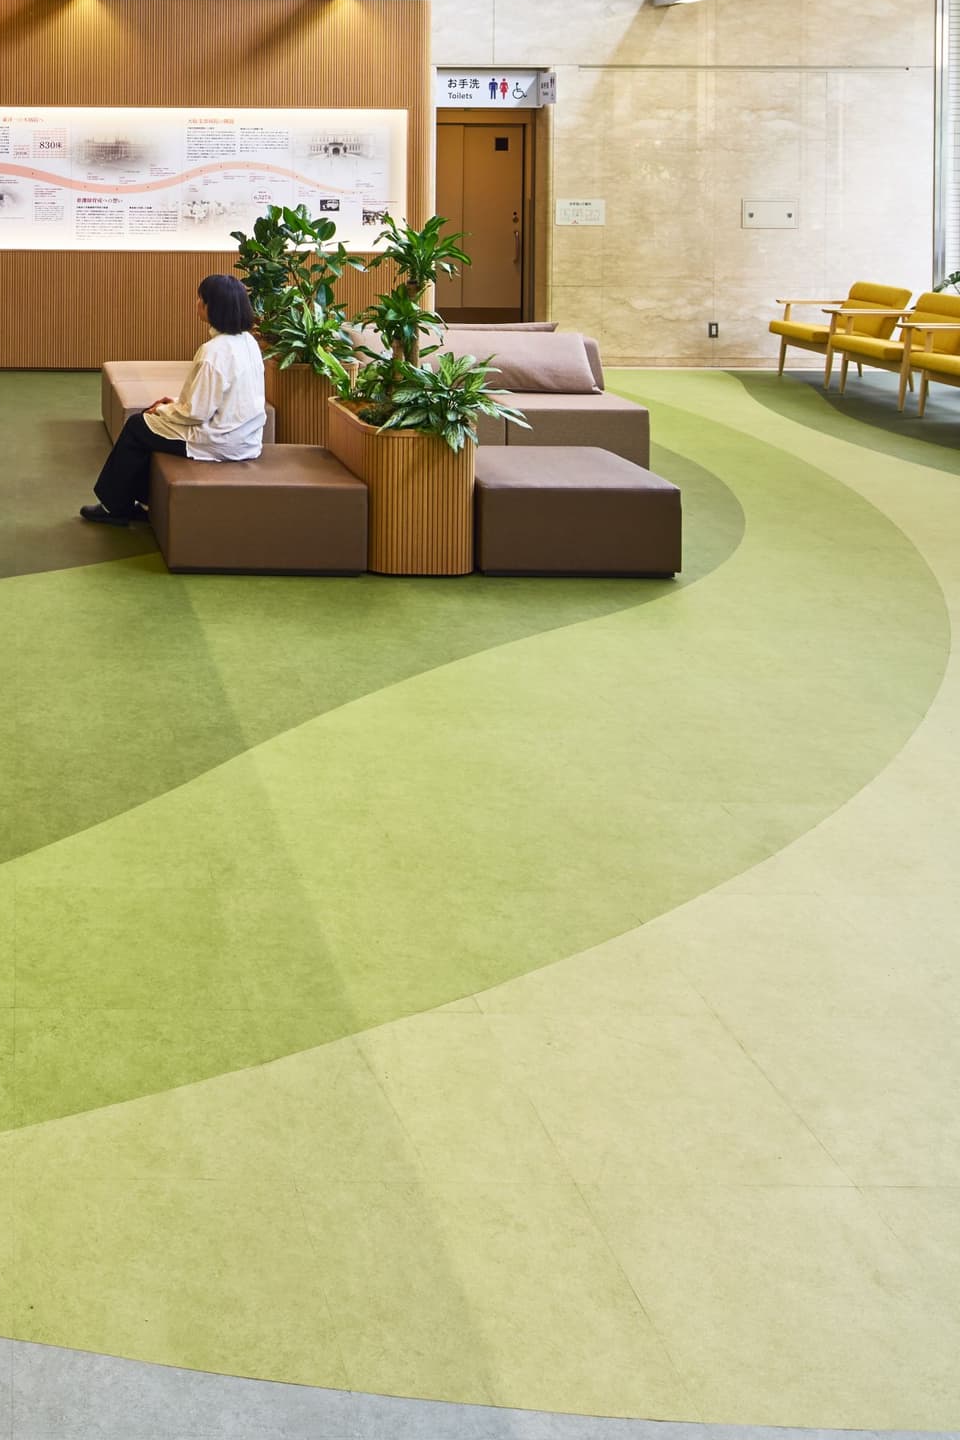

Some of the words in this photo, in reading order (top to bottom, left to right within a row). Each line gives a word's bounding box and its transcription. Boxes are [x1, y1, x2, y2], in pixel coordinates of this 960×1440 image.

[447, 78, 480, 89] お手洗
[448, 92, 472, 100] Toilets
